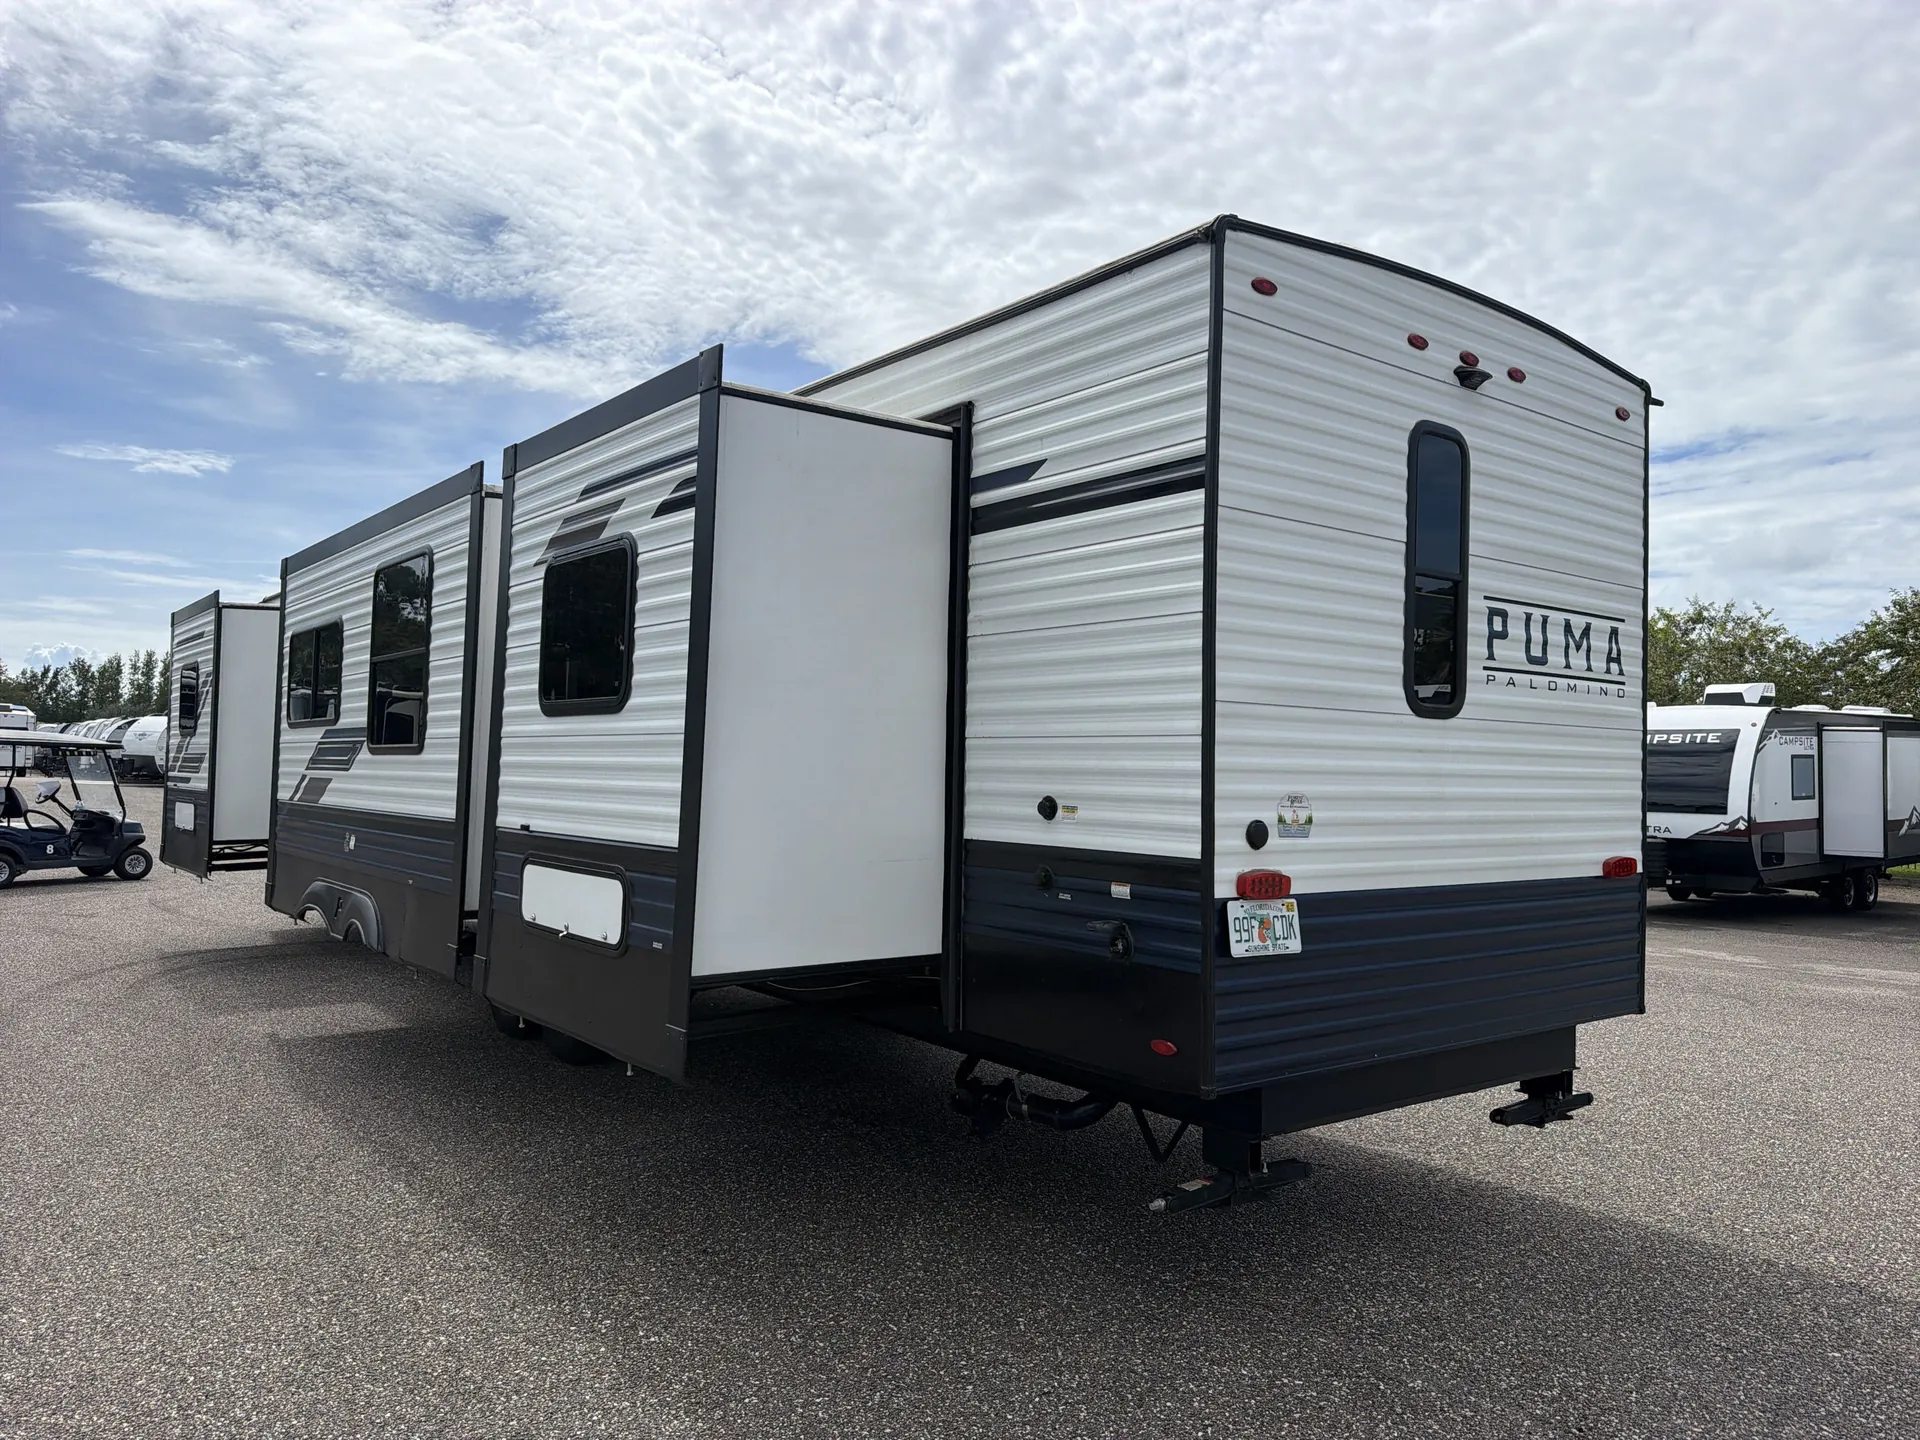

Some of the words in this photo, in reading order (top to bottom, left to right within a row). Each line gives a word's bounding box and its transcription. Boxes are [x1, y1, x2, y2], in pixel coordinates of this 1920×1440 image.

[1485, 606, 1625, 676] PUMA
[1486, 675, 1625, 698] PALOMINO
[1779, 736, 1814, 746] CAMPSITE
[46, 844, 54, 854] 8
[1233, 916, 1257, 944] 99F
[1272, 914, 1297, 941] CDK
[1247, 944, 1271, 953] SUNSHINE
[1272, 943, 1287, 952] STATE
